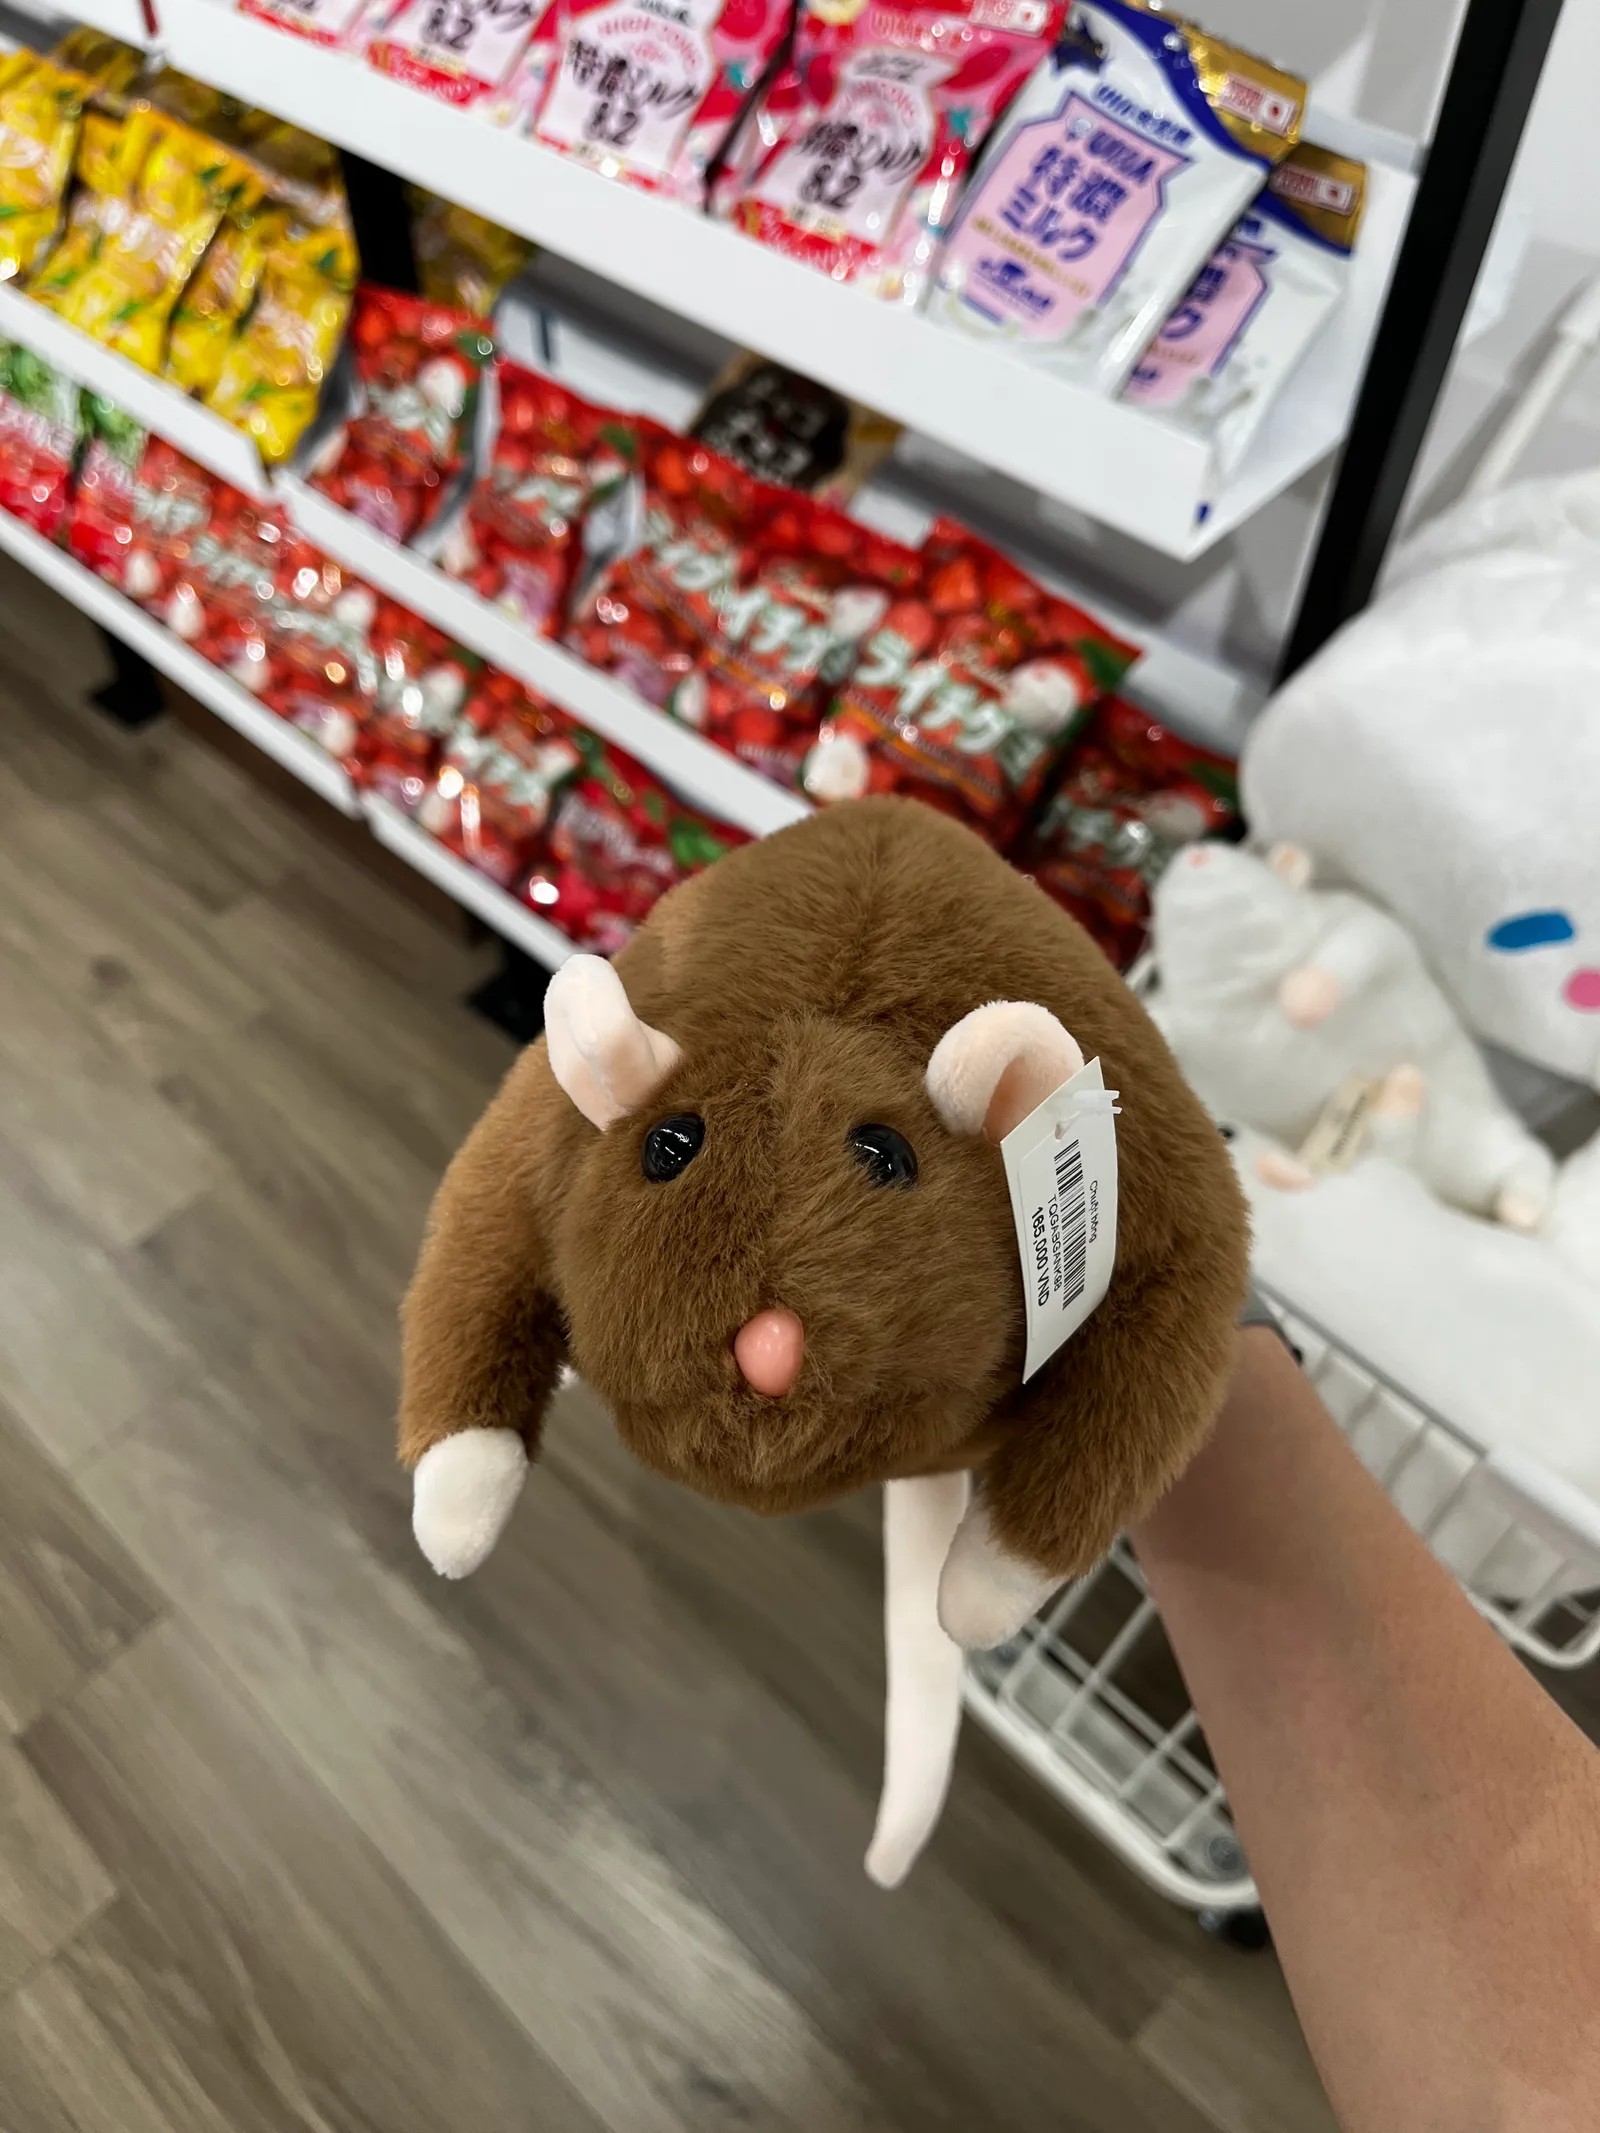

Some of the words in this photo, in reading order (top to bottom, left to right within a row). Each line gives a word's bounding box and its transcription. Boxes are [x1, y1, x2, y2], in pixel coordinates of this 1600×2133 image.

[1002, 186, 1097, 262] ミルク
[1031, 1206, 1049, 1271] 165,000
[1037, 1267, 1050, 1307] VND
